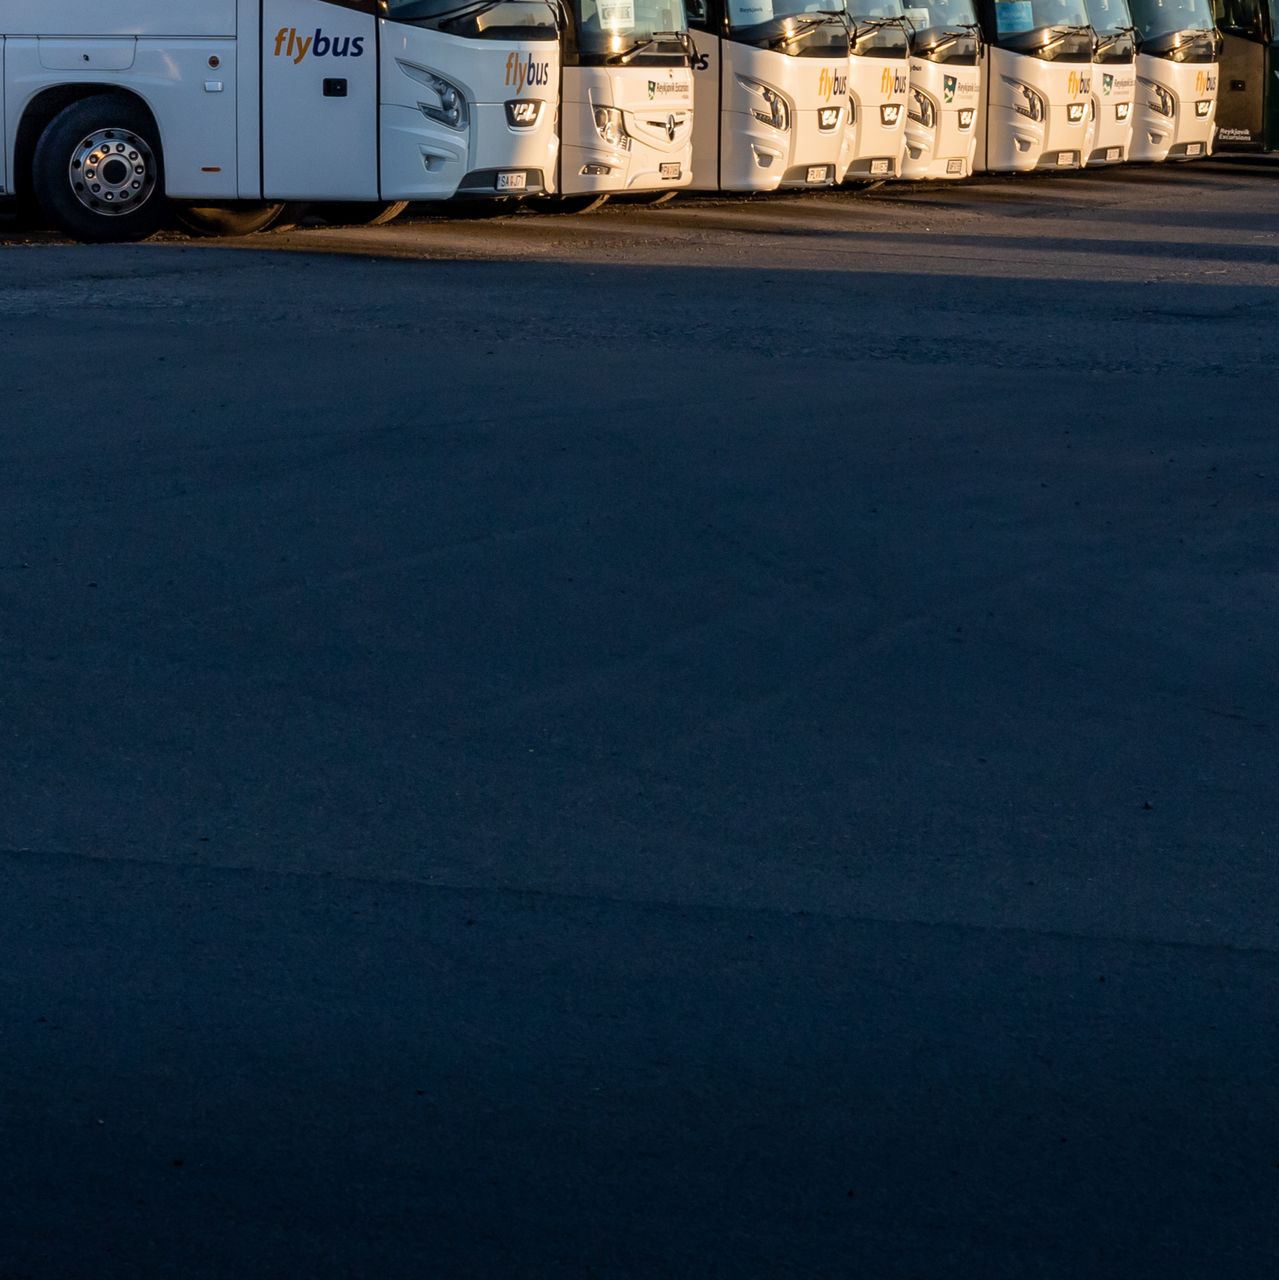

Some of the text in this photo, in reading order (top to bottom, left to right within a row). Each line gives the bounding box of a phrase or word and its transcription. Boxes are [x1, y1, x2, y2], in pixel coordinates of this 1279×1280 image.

[273, 27, 364, 64] flybus
[505, 52, 549, 95] flybus
[819, 67, 848, 102] flybus
[881, 67, 907, 100] flybus
